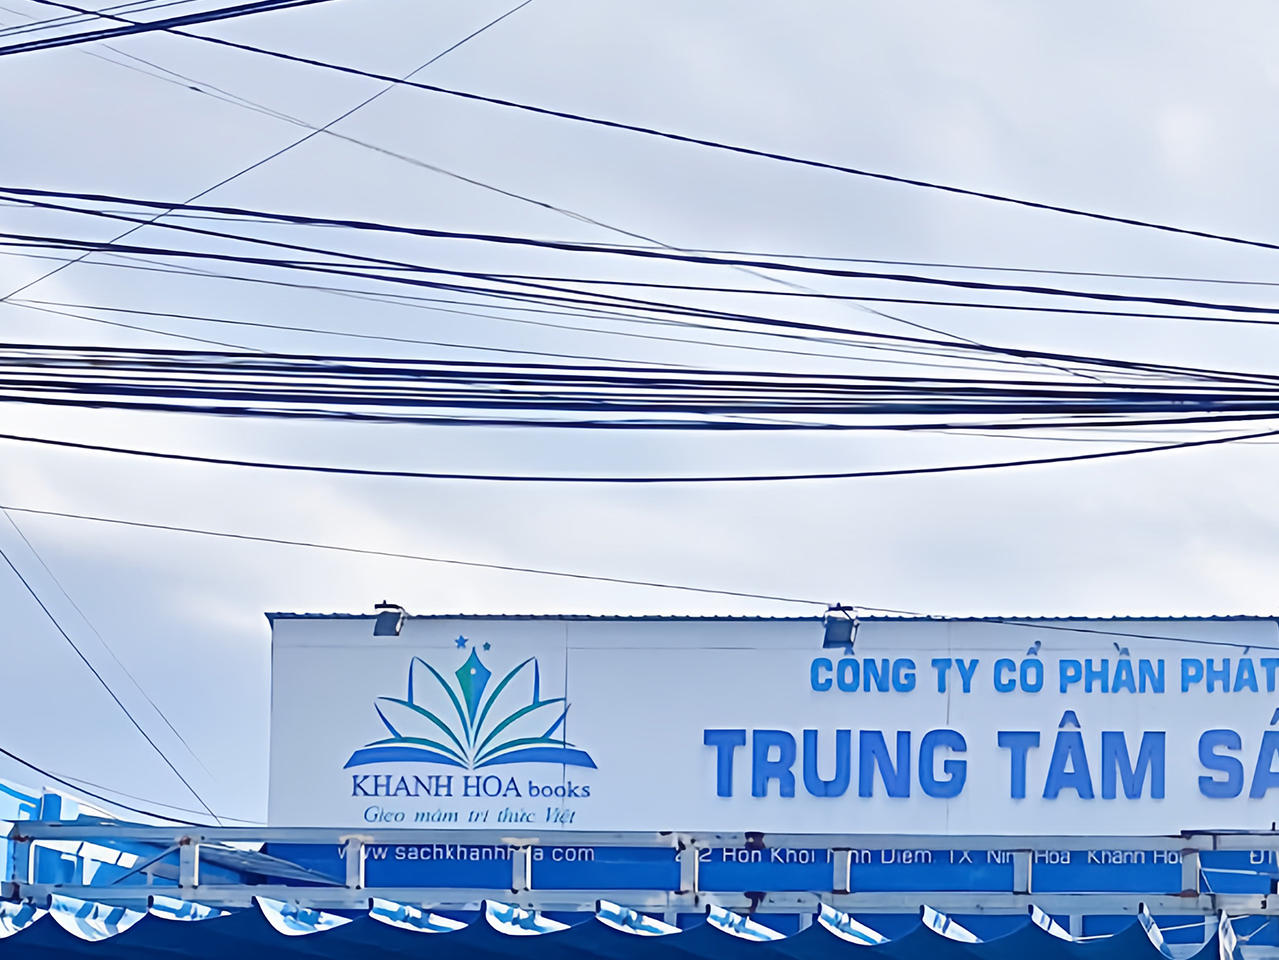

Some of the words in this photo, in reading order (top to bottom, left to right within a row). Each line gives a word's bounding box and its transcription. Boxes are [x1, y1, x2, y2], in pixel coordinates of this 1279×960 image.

[810, 647, 916, 693] CÔNG
[931, 658, 979, 694] TY
[993, 640, 1044, 693] CỔ
[1059, 642, 1165, 694] PHẦN
[704, 729, 968, 798] TRUNG
[998, 710, 1166, 799] TÂM
[351, 775, 453, 797] KHANH
[462, 775, 522, 797] HOA
[528, 780, 591, 798] books
